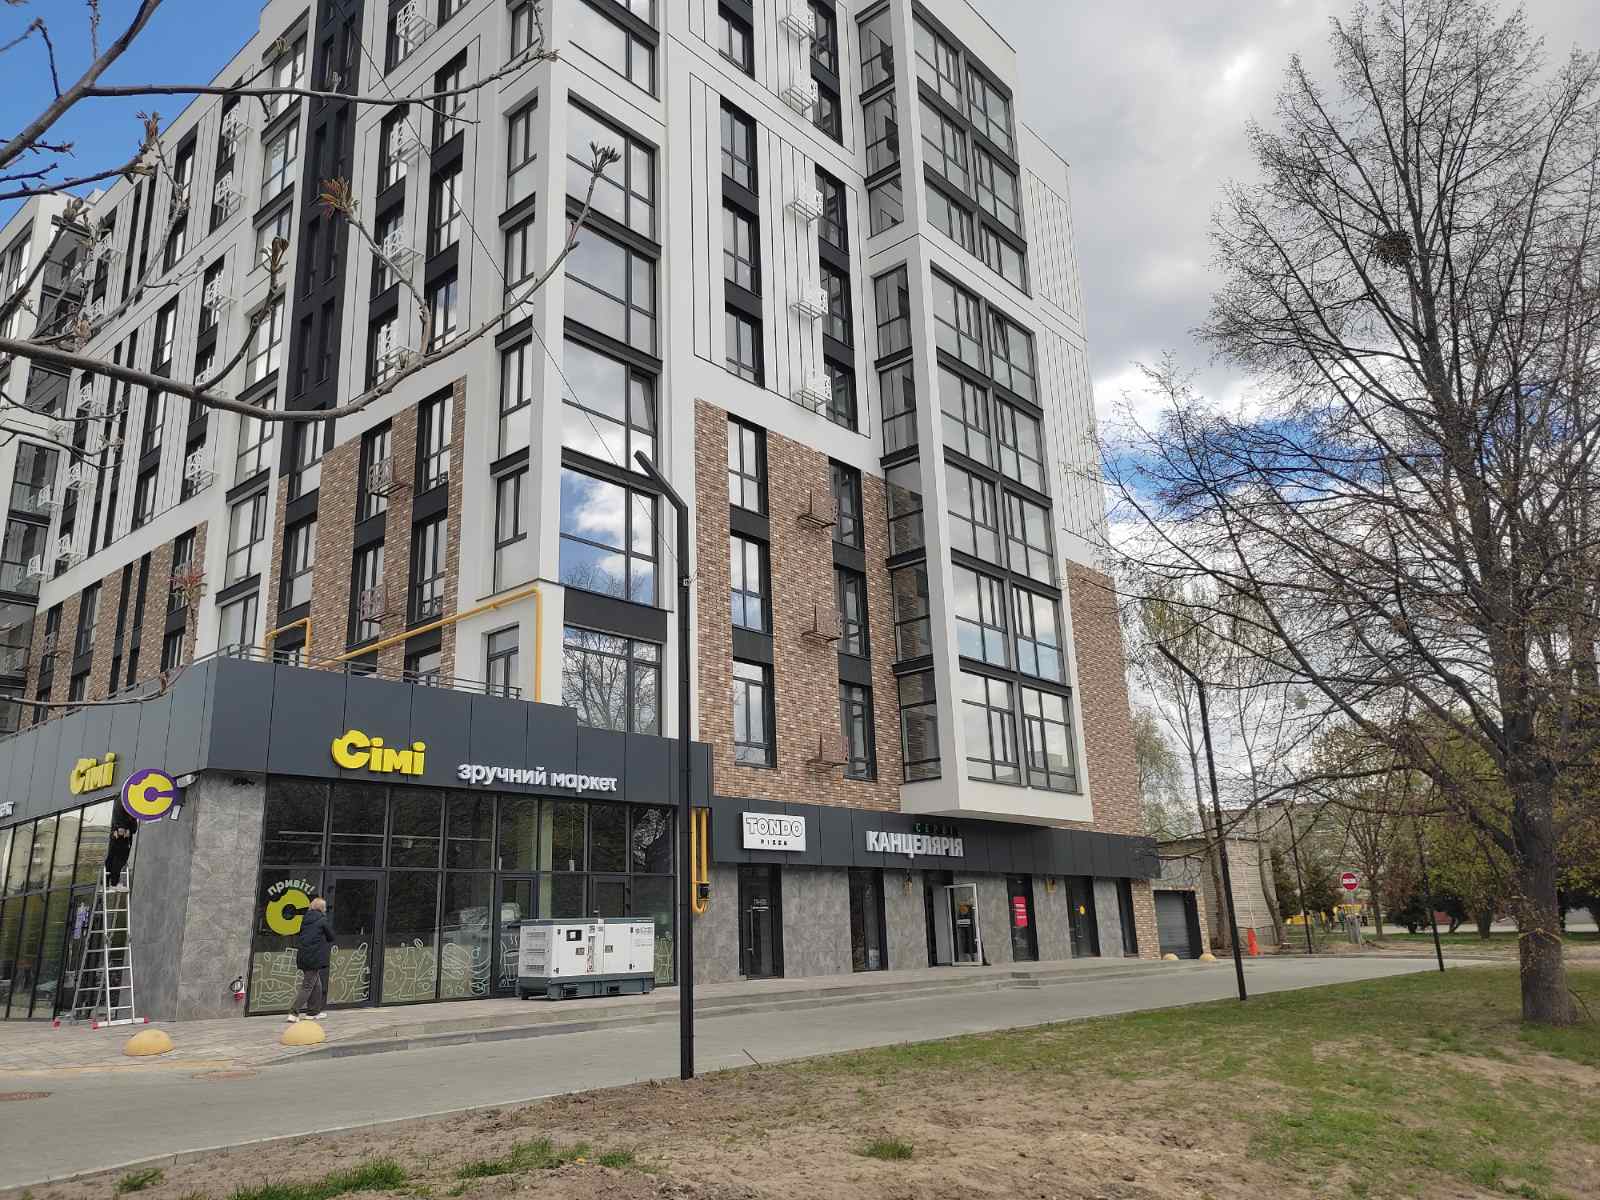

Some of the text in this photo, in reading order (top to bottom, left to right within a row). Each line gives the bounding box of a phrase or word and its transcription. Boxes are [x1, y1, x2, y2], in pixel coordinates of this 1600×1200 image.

[457, 763, 618, 793] зручний маркет
[745, 817, 803, 838] TONDO
[865, 830, 964, 858] КАНЦЕЛЯРІЯ
[267, 879, 316, 896] привіт!
